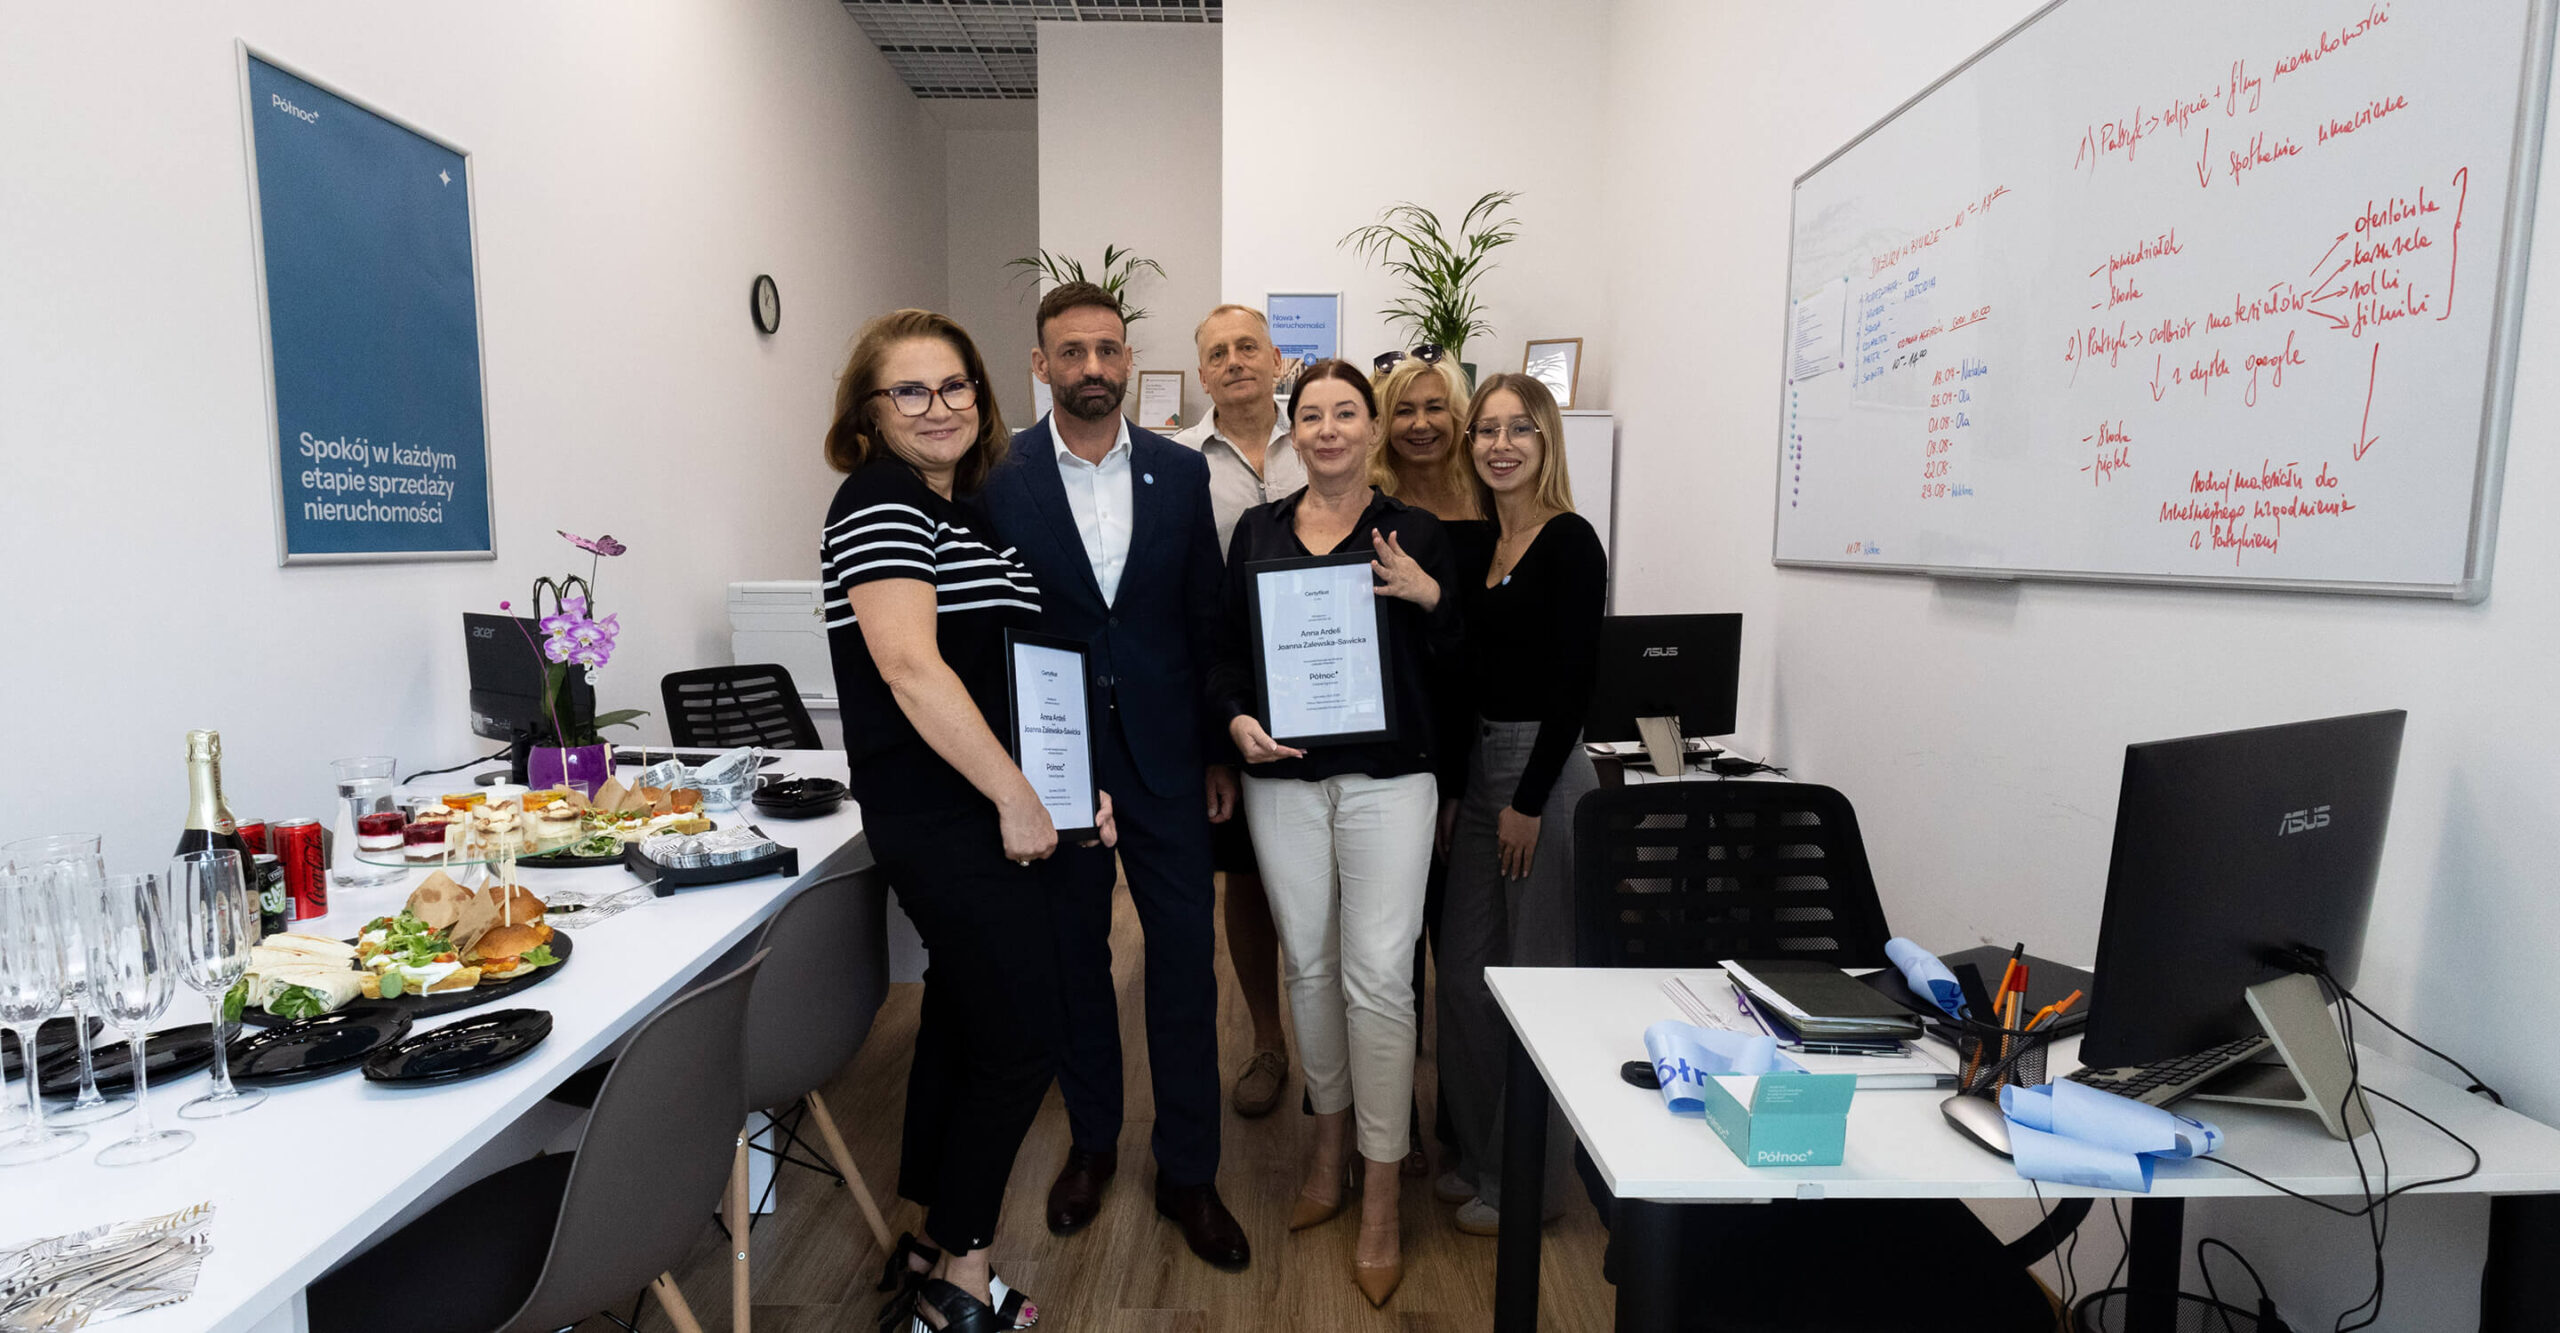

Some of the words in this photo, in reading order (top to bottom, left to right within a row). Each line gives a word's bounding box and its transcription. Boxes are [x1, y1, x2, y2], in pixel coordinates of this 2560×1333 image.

[271, 93, 315, 124] Północ
[2087, 320, 2127, 368] Patryk
[300, 432, 369, 468] Spokój
[372, 446, 389, 463] w
[393, 442, 456, 473] każdym
[301, 468, 365, 496] etapie
[369, 474, 454, 502] sprzedaży
[2315, 462, 2338, 488] do
[304, 496, 442, 524] nieruchomości
[473, 626, 495, 638] acer
[1300, 630, 1319, 638] Anna
[1277, 643, 1303, 651] Joanna
[1643, 647, 1678, 657] ASUS
[2279, 805, 2331, 836] ASUS
[1758, 1151, 1807, 1163] Północ
